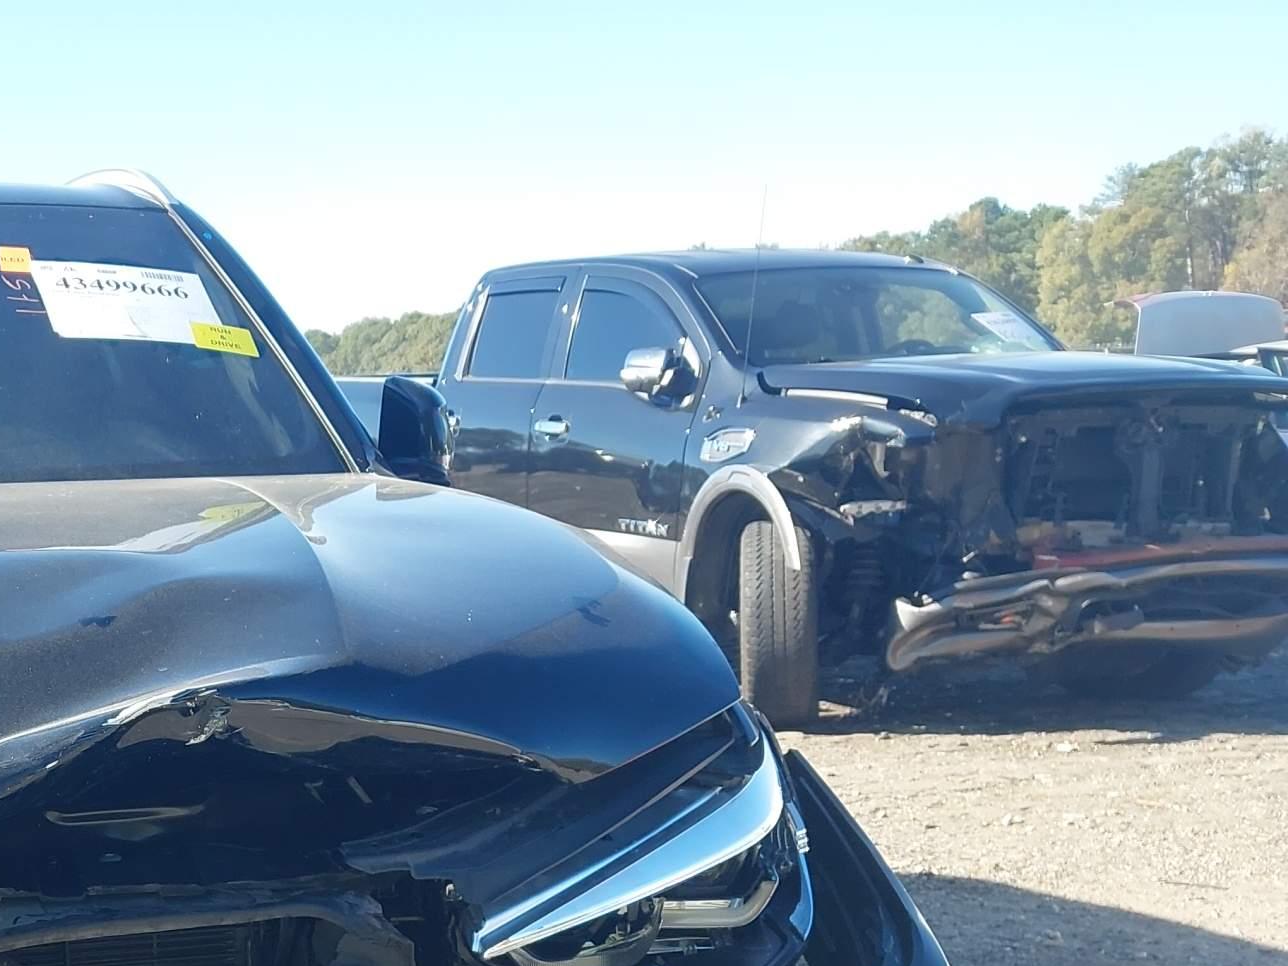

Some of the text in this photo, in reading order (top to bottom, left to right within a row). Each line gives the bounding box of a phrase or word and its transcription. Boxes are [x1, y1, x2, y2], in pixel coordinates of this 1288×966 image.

[56, 276, 189, 299] 43499666
[210, 339, 242, 350] DRIVE
[618, 518, 669, 537] TITAN
